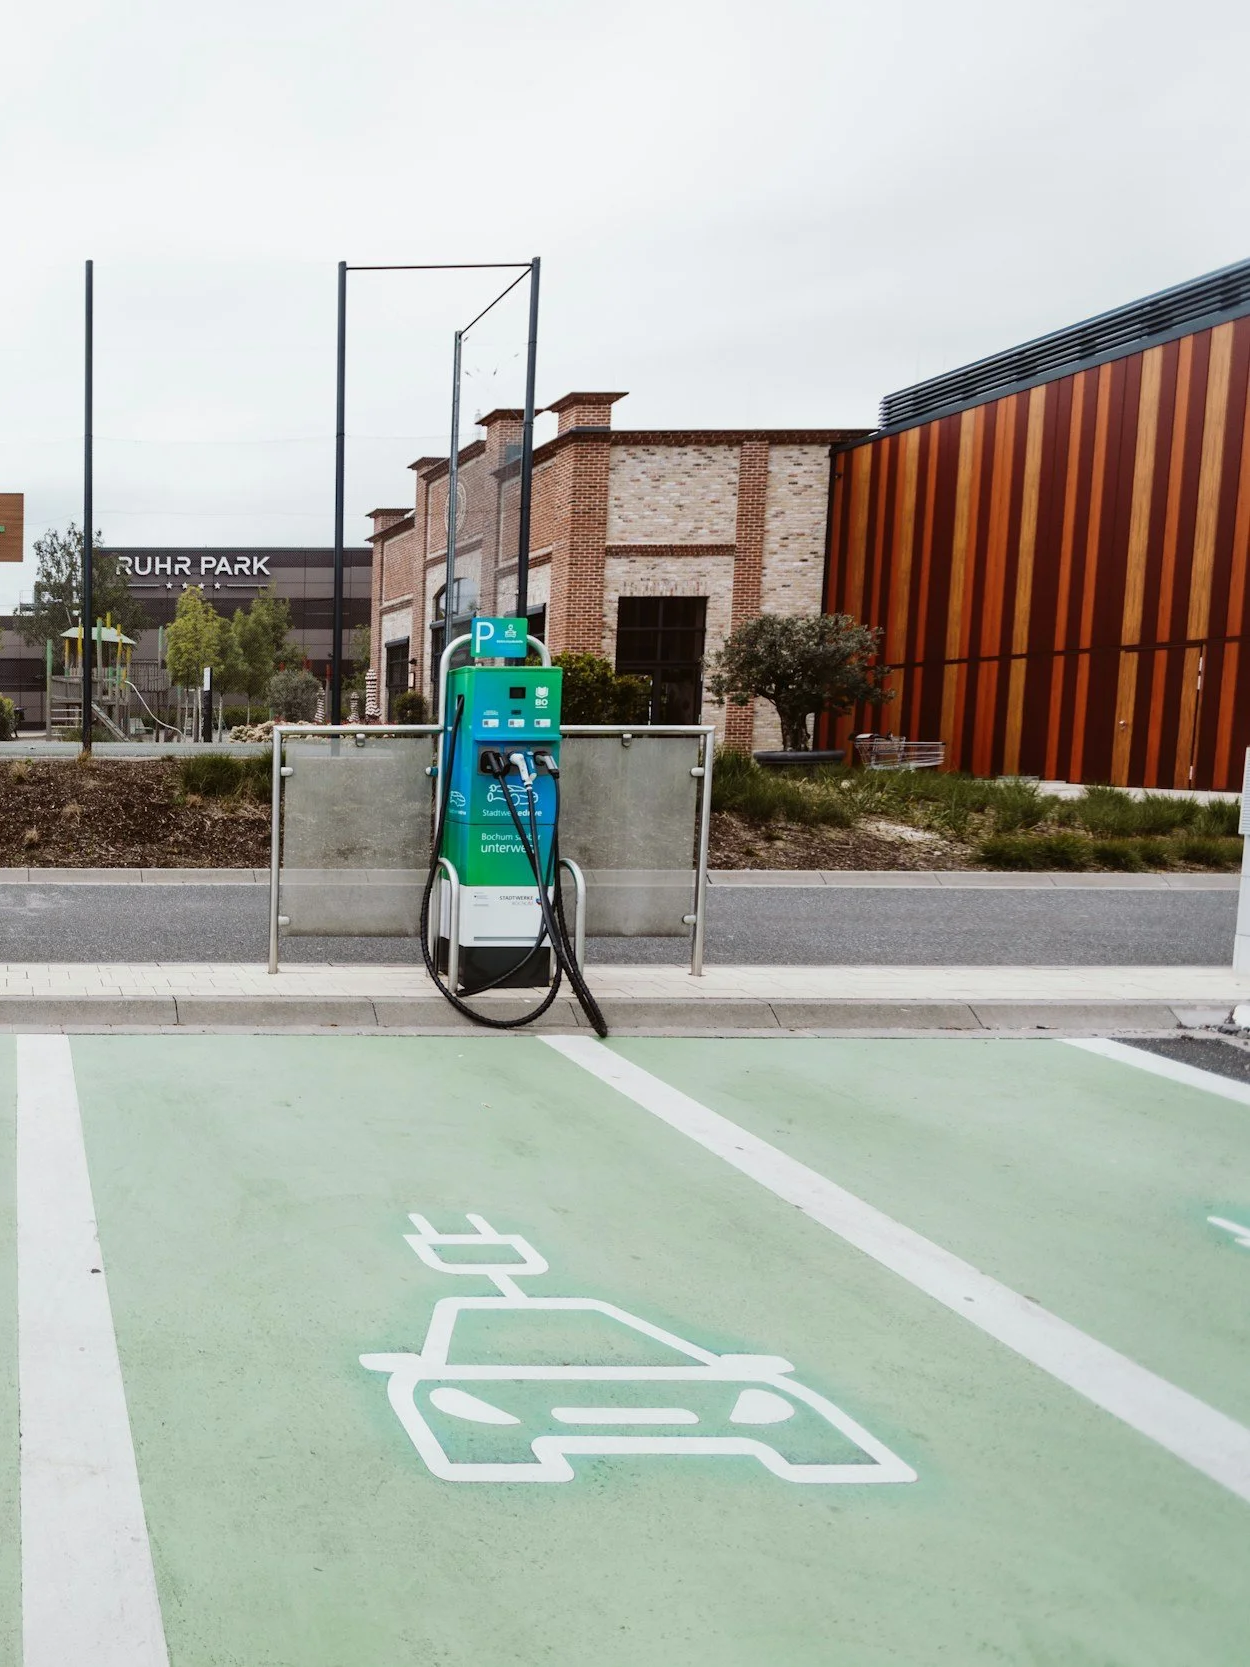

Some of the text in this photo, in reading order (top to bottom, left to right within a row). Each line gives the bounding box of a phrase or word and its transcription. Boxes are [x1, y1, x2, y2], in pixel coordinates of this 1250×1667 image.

[116, 556, 271, 576] RUHR PARK
[475, 621, 495, 654] P
[535, 698, 549, 706] BO
[481, 833, 513, 841] Bochum
